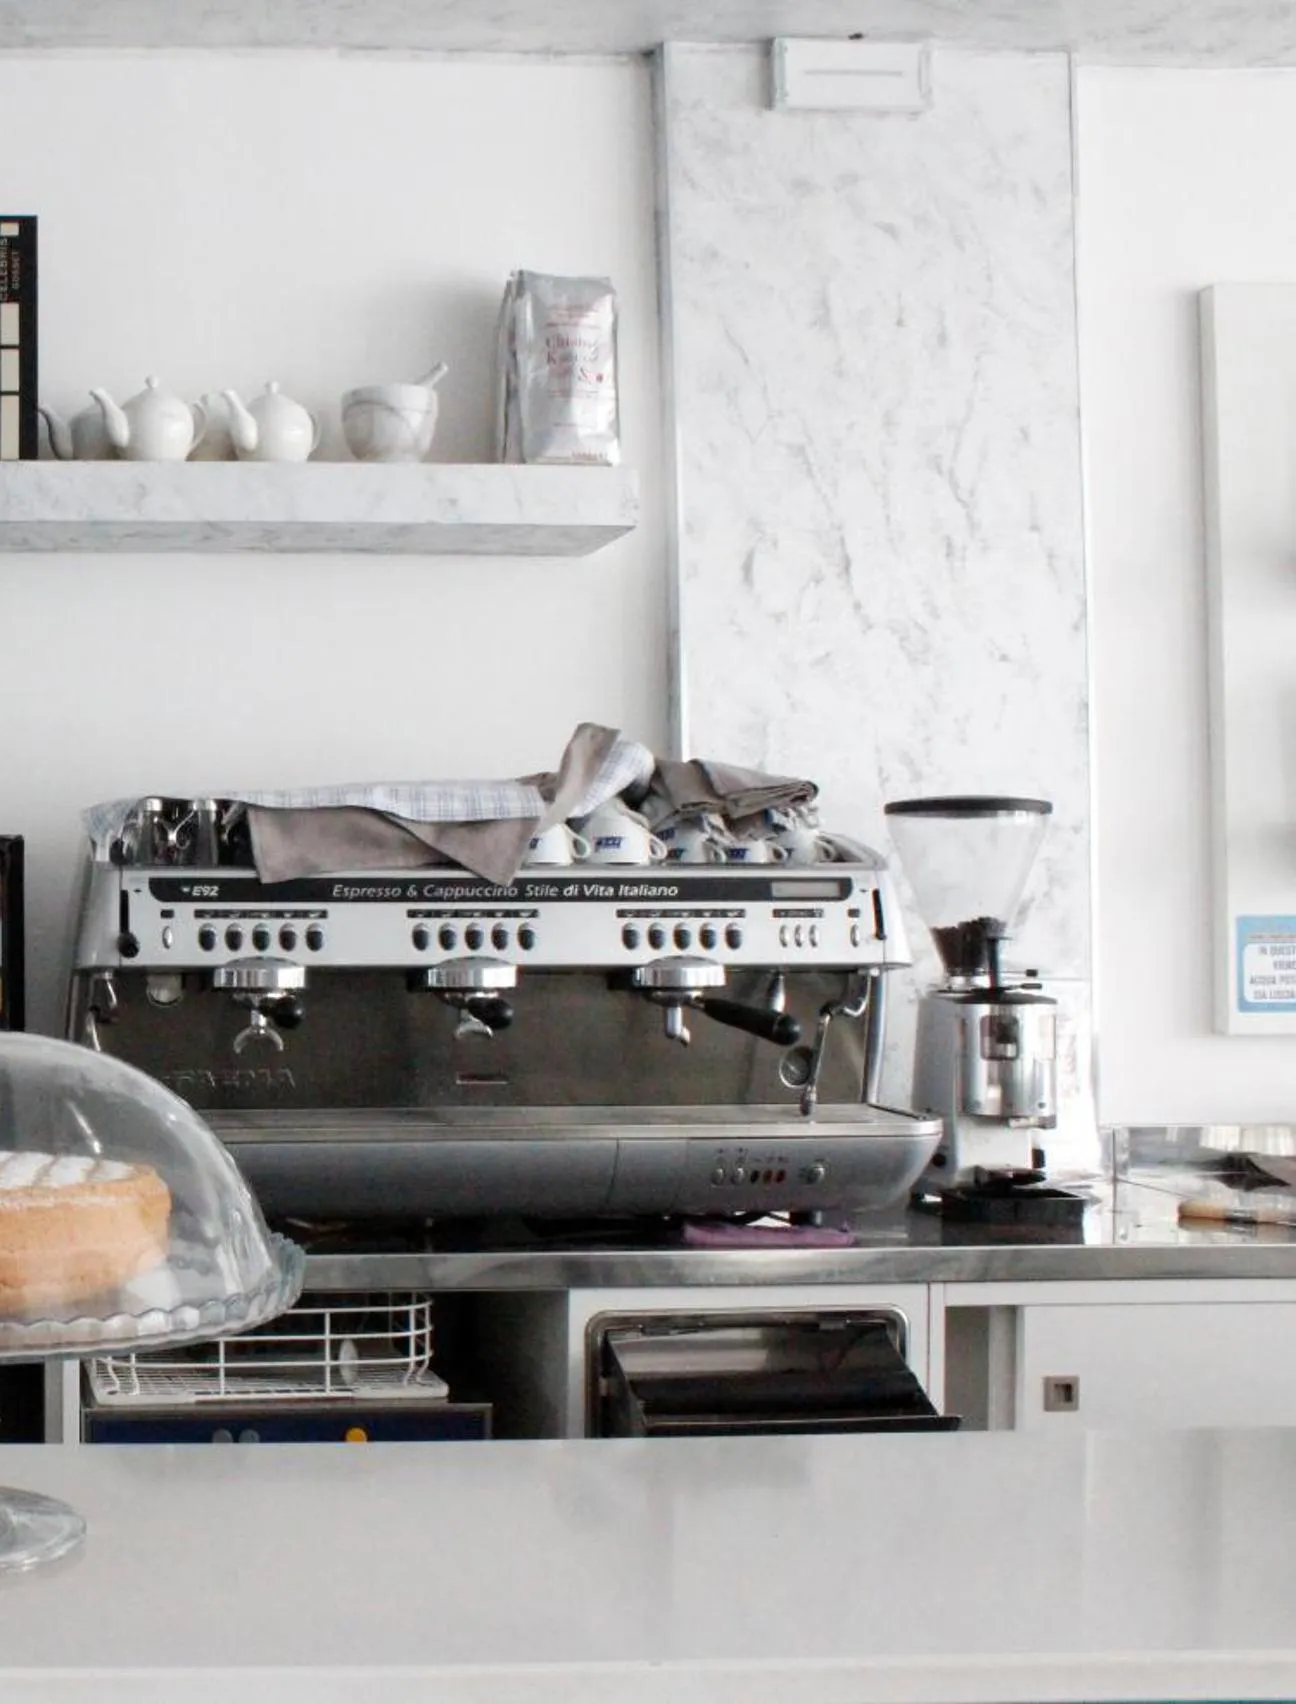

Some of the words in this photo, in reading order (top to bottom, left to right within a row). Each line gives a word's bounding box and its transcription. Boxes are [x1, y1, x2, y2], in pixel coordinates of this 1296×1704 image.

[192, 885, 219, 897] E92
[332, 884, 401, 899] Espresso
[406, 884, 418, 898] &
[423, 884, 519, 899] Cappuccino
[525, 884, 559, 897] Stile
[563, 884, 580, 897] di
[584, 884, 615, 897] Vita
[618, 884, 679, 897] Italiano
